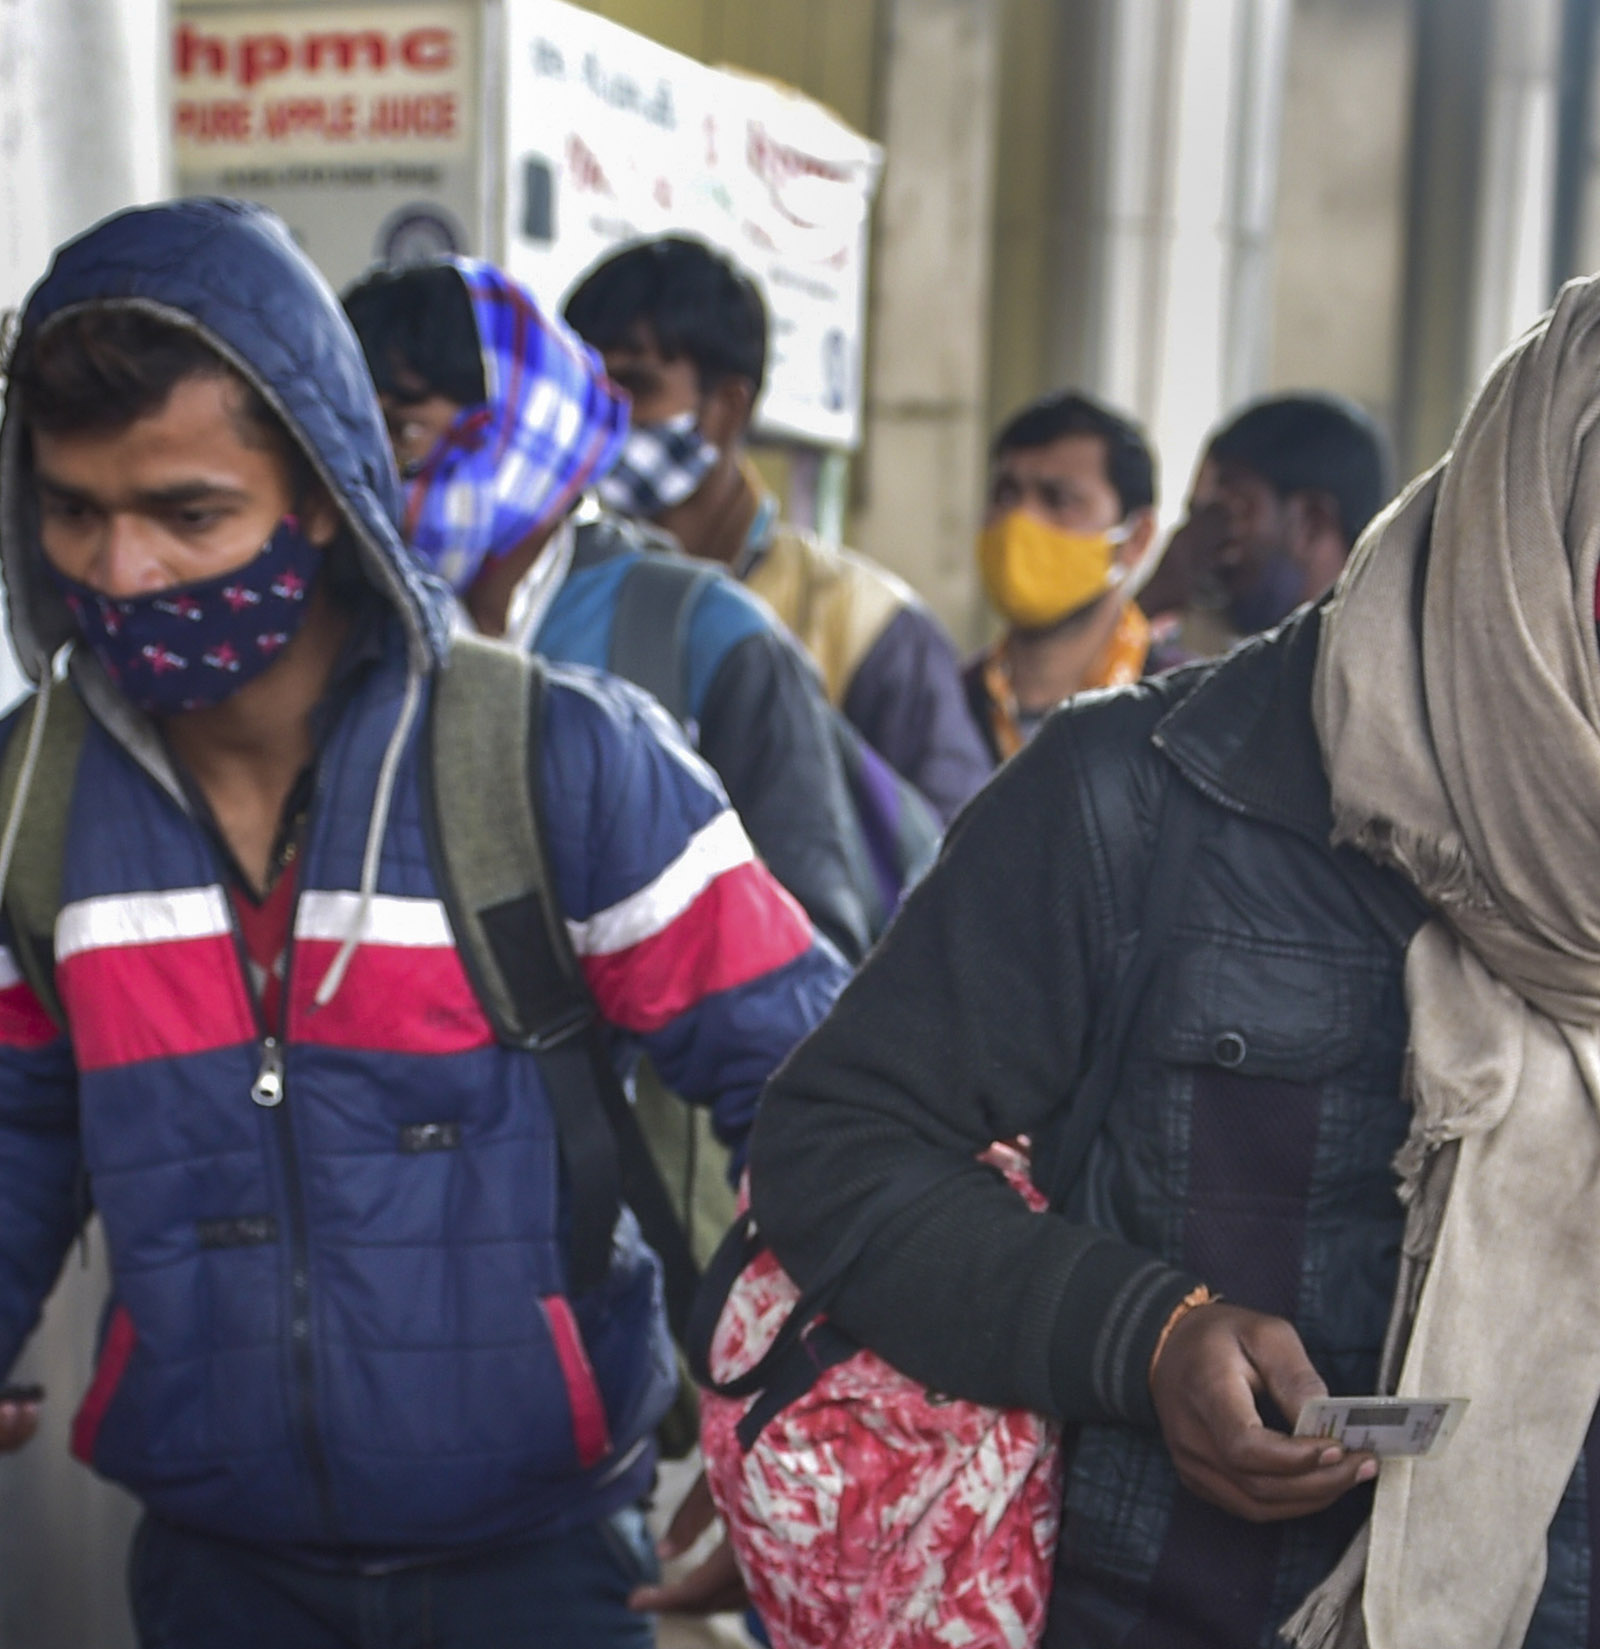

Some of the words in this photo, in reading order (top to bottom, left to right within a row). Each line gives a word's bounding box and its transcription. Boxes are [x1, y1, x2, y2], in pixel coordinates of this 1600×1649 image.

[173, 23, 455, 88] hpmc
[175, 101, 251, 142] PURE
[262, 100, 355, 141] APPLE
[369, 92, 456, 139] JUICE
